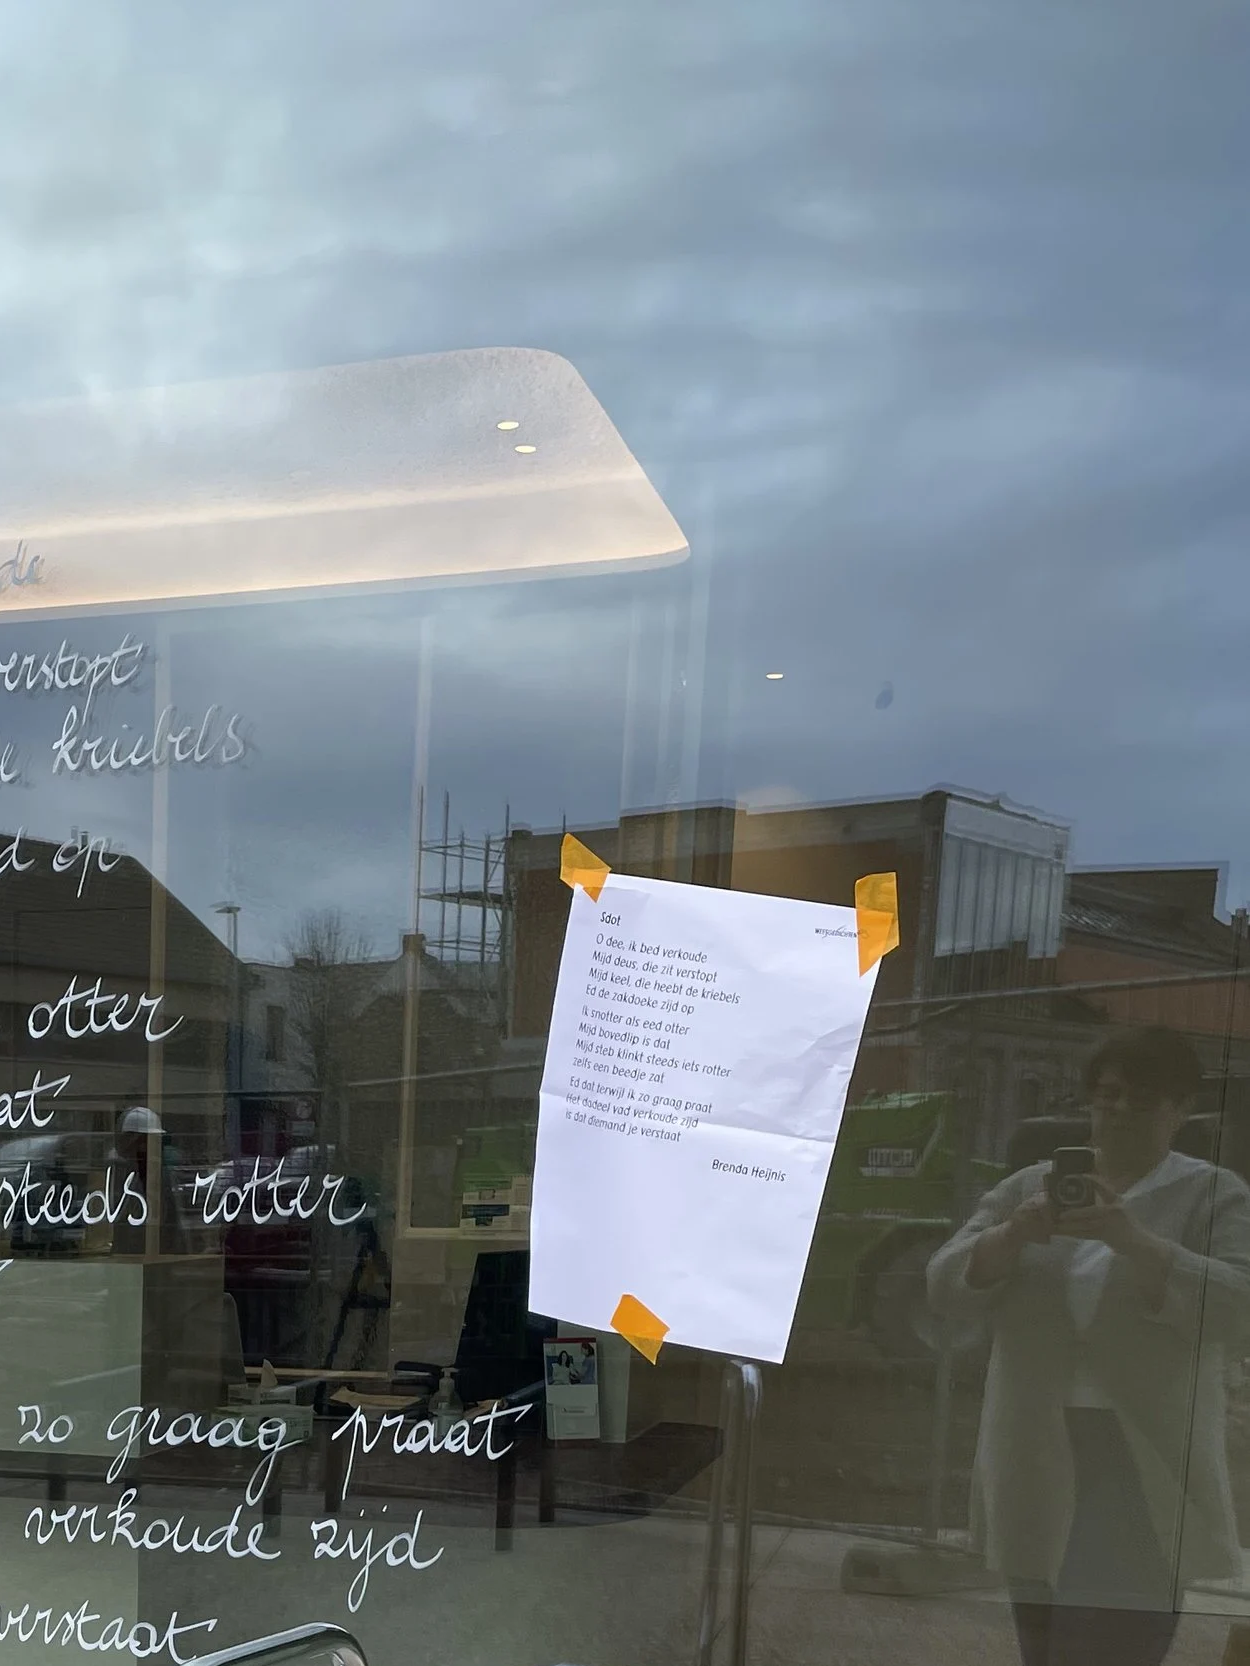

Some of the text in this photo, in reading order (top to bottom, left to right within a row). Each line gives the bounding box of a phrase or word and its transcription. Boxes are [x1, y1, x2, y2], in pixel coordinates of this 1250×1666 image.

[52, 704, 244, 774] kriebels
[52, 834, 122, 898] op
[600, 911, 621, 926] Sdot
[596, 933, 708, 963] O dee, ik bed verkoude
[592, 950, 718, 984] Mijd deus, die zit verstopt
[586, 984, 695, 1016] Ed de zakdoeke zijd op
[588, 967, 741, 1004] Mijd keel, die heebt de kriebels
[28, 975, 184, 1042] otter
[581, 1005, 690, 1036] Ik snotter als eed otter
[578, 1022, 671, 1050] Mijd bovedlip is dat
[573, 1056, 665, 1084] zelfs een beedje zat
[575, 1038, 732, 1078] Mijd steb klinkt steeds iets rotter
[566, 1093, 699, 1129] Het dadeel vad verkoude zijd
[570, 1076, 713, 1114] Ed dat terwijl ik zo graag praat
[565, 1108, 682, 1142] is dat diemand je verstaat
[711, 1158, 787, 1182] Brenda Heijnis
[190, 1156, 367, 1227] rotter
[18, 1405, 75, 1446] zo
[106, 1406, 310, 1506] graag
[332, 1400, 533, 1501] praat
[25, 1487, 282, 1560] verkoude
[311, 1504, 445, 1613] zijd
